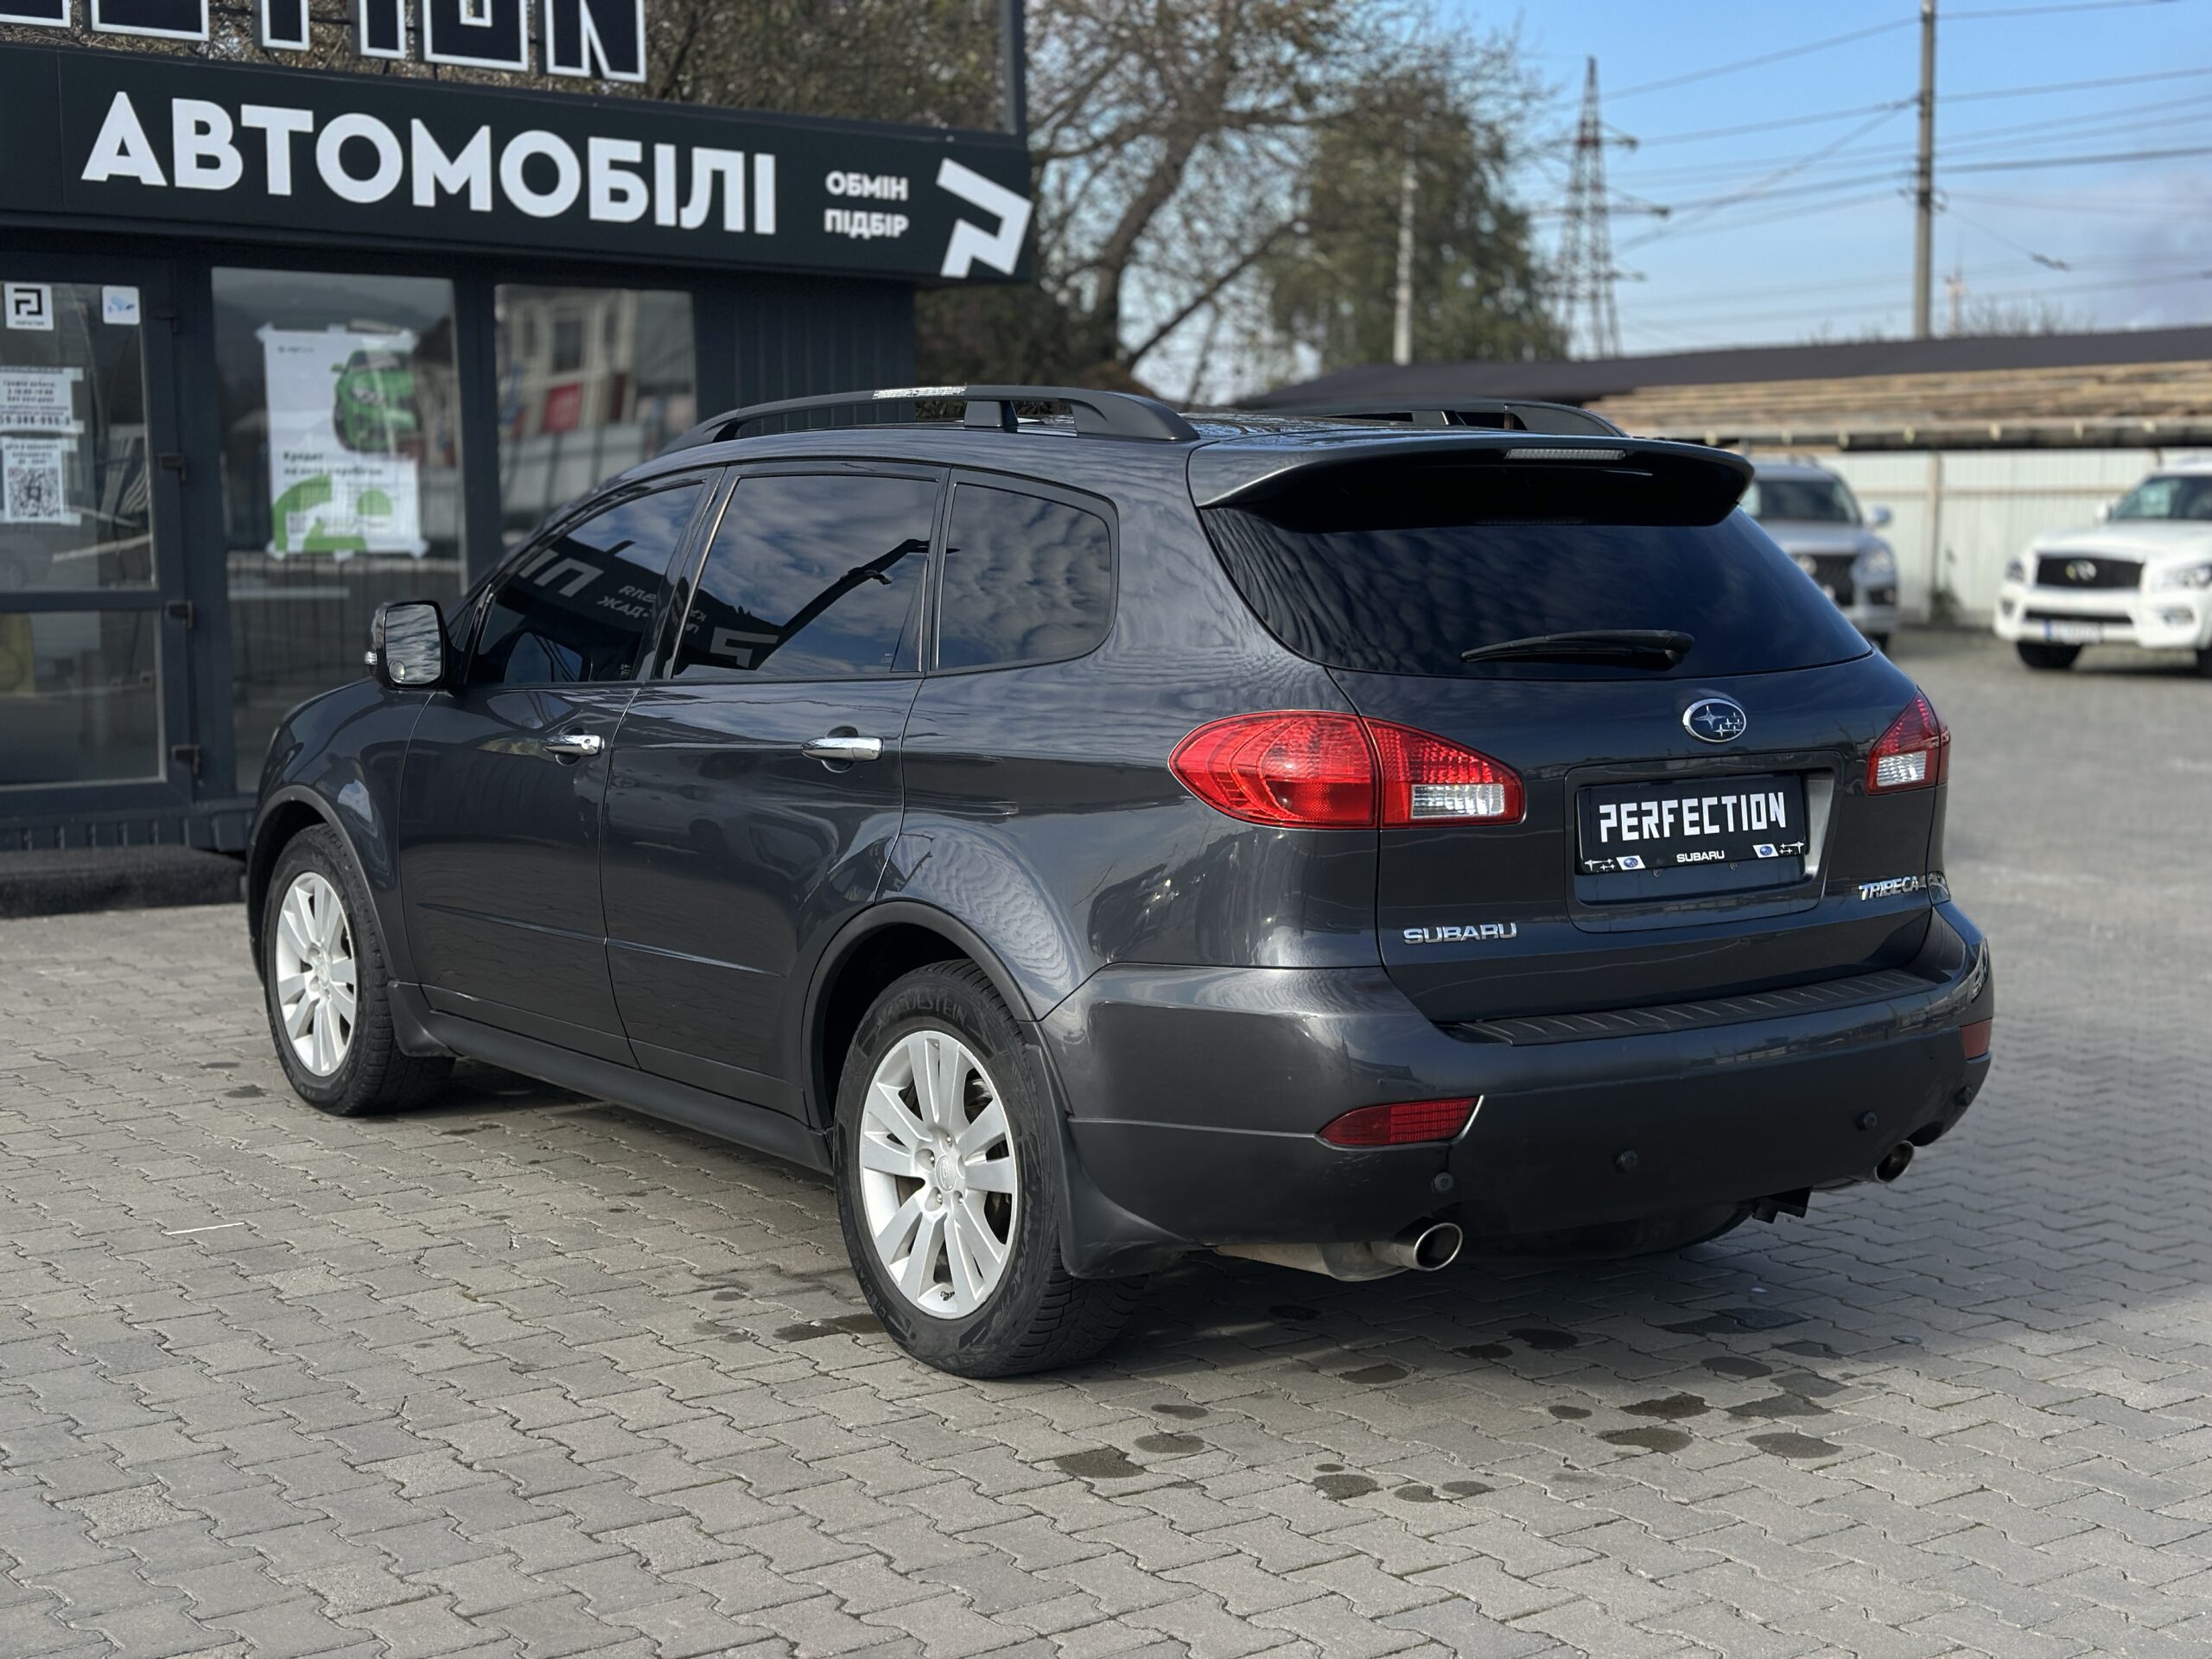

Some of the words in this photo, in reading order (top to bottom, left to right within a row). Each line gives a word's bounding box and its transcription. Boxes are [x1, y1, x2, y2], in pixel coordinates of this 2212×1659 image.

[81, 91, 776, 234] АВТОМОБІЛІ
[825, 171, 908, 200] ОБМІН
[824, 208, 909, 239] ПІДБІР
[1599, 791, 1786, 842] PERFECTION
[1676, 850, 1725, 862] SUBARU
[1859, 875, 1919, 900] TRIBECA
[1403, 922, 1517, 944] SUBARU
